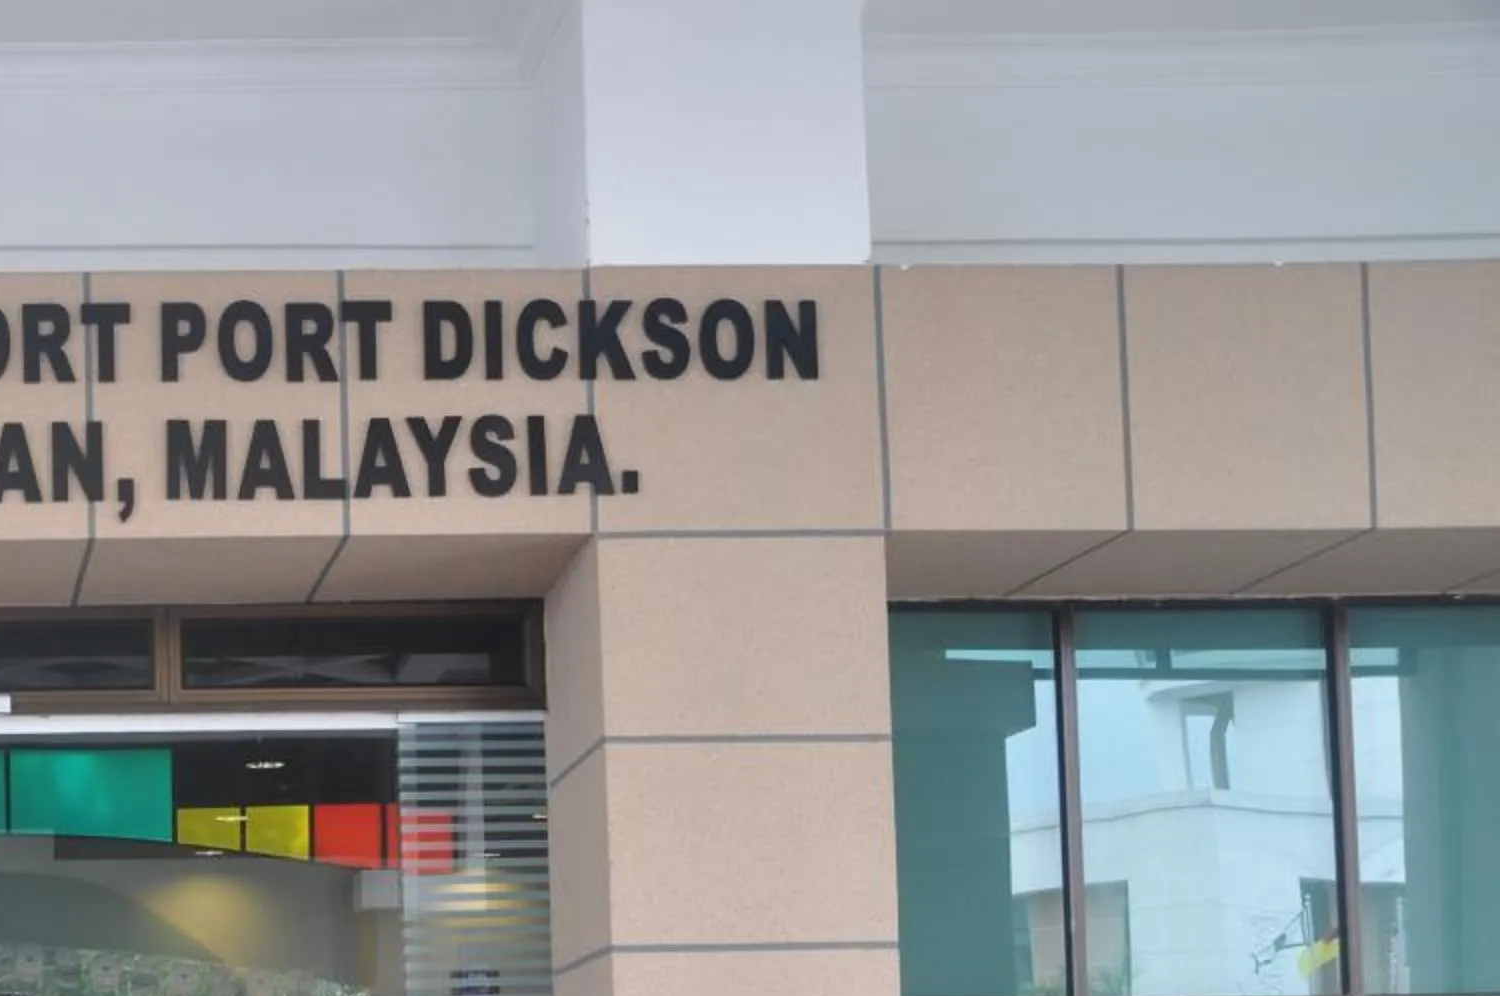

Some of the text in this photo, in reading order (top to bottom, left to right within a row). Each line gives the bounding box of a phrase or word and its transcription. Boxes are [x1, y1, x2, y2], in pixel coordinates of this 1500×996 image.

[162, 301, 391, 381] PORT
[424, 299, 818, 380] DICKSON
[168, 415, 638, 499] MALAYSIA.
